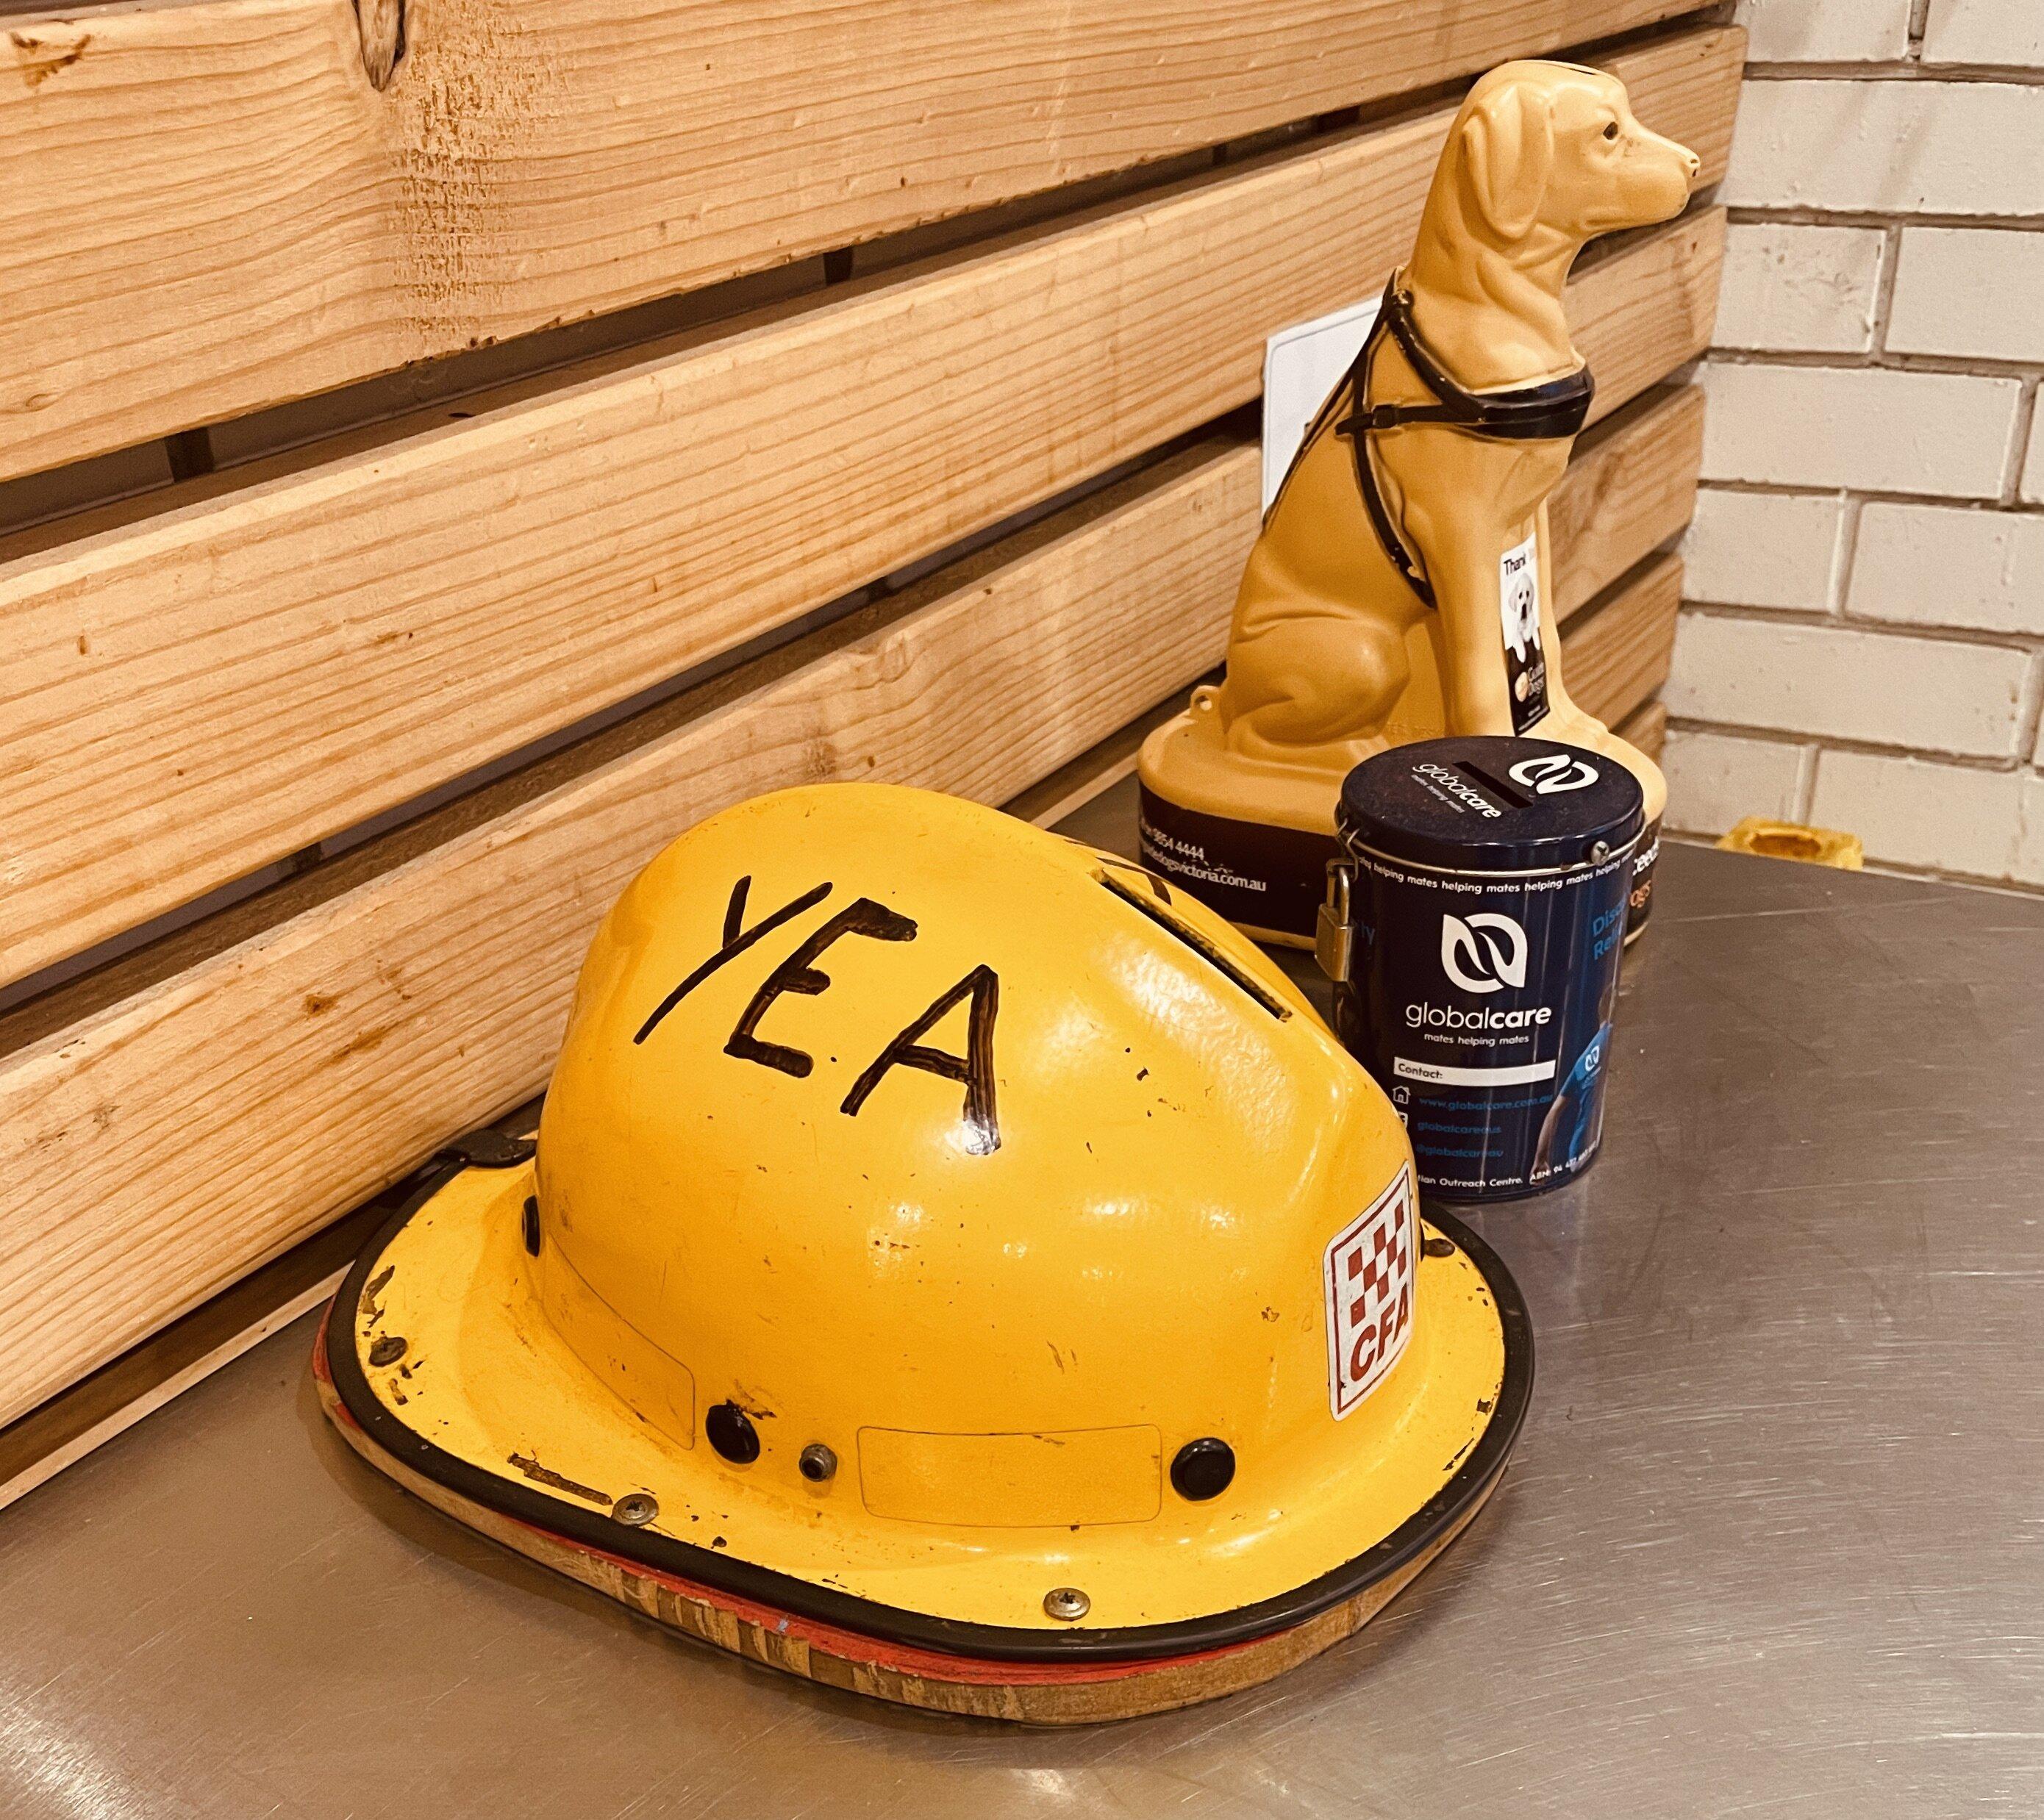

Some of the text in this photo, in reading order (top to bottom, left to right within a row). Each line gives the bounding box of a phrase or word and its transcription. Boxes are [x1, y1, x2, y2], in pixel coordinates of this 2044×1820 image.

[1412, 763, 1501, 817] globalcare
[1407, 875, 1438, 889] mates
[1442, 880, 1483, 895] helping
[1486, 884, 1521, 893] mates
[1524, 879, 1563, 892] helping
[1566, 873, 1593, 886] mates
[633, 875, 1001, 1156] YEA
[1406, 1001, 1552, 1029] globalcare
[1423, 1033, 1530, 1047] mates helping mates
[1398, 1063, 1443, 1079] Contact:
[1419, 1094, 1554, 1112] www.globalcare.com.au
[1439, 1178, 1486, 1188] Outreach
[1350, 1282, 1409, 1383] CFA
